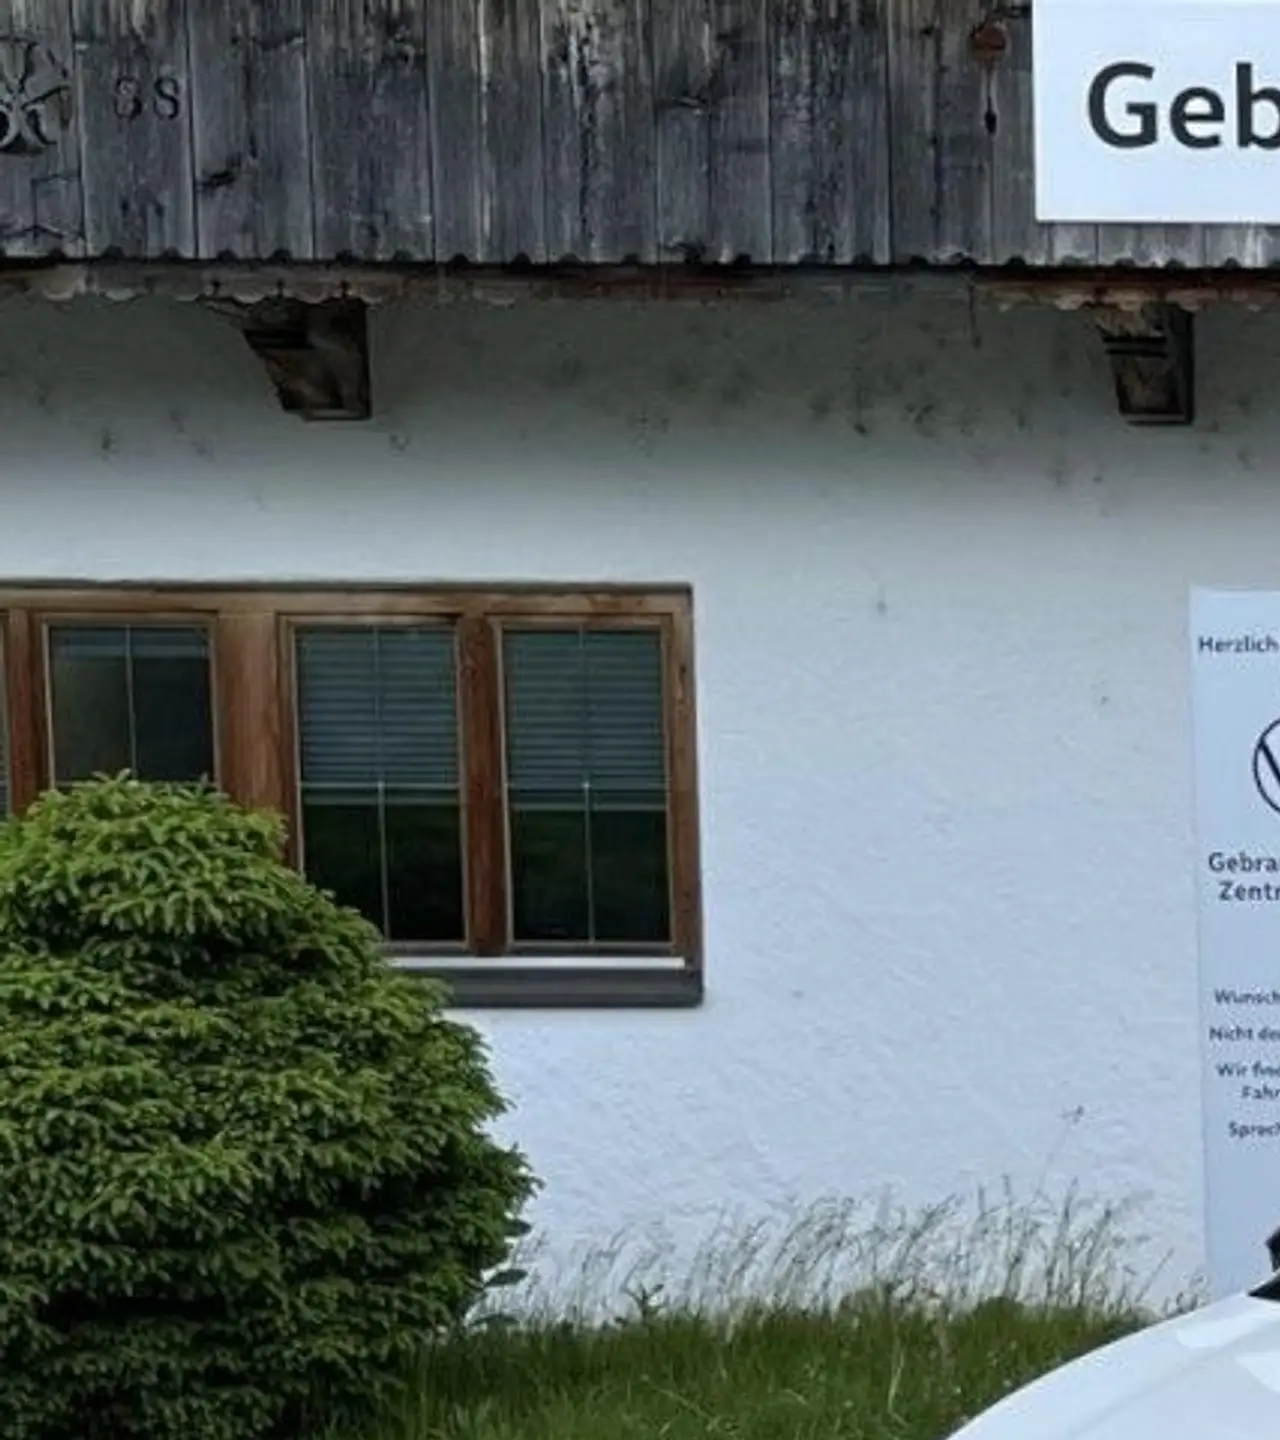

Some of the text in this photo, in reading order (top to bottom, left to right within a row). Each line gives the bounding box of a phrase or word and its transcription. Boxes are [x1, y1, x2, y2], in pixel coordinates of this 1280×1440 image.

[1198, 635, 1279, 654] Herzlich
[1209, 1025, 1254, 1042] Nicht
[1217, 1062, 1248, 1078] Wir
